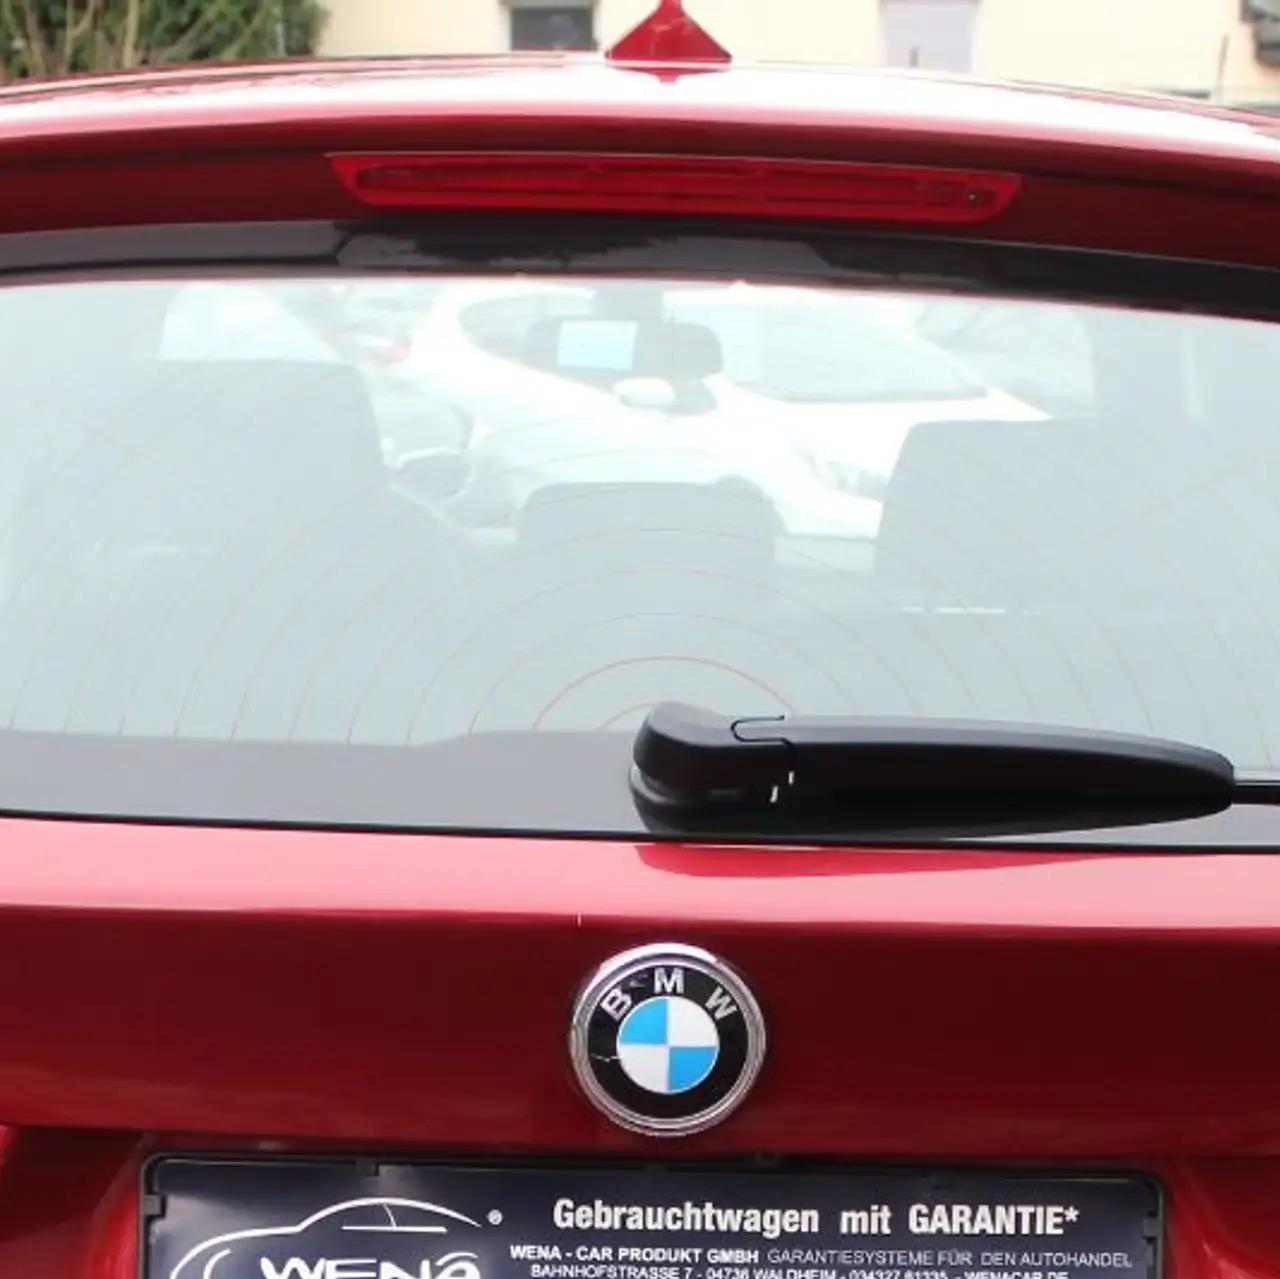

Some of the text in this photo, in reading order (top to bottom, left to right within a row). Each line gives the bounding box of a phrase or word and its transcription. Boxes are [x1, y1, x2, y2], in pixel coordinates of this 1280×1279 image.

[600, 966, 738, 1022] BMW
[553, 1197, 819, 1239] Gebrauchtwagen
[839, 1204, 891, 1235] mit
[510, 1244, 562, 1261] WENA
[575, 1246, 613, 1262] CAR
[618, 1247, 702, 1263] PRODUKT
[706, 1247, 759, 1264] GMBH
[767, 1248, 934, 1267] GARANTIESYSTEME
[937, 1248, 973, 1267] FÜR
[980, 1252, 1016, 1267] DEN
[1019, 1252, 1133, 1268] AUTOHANDEL
